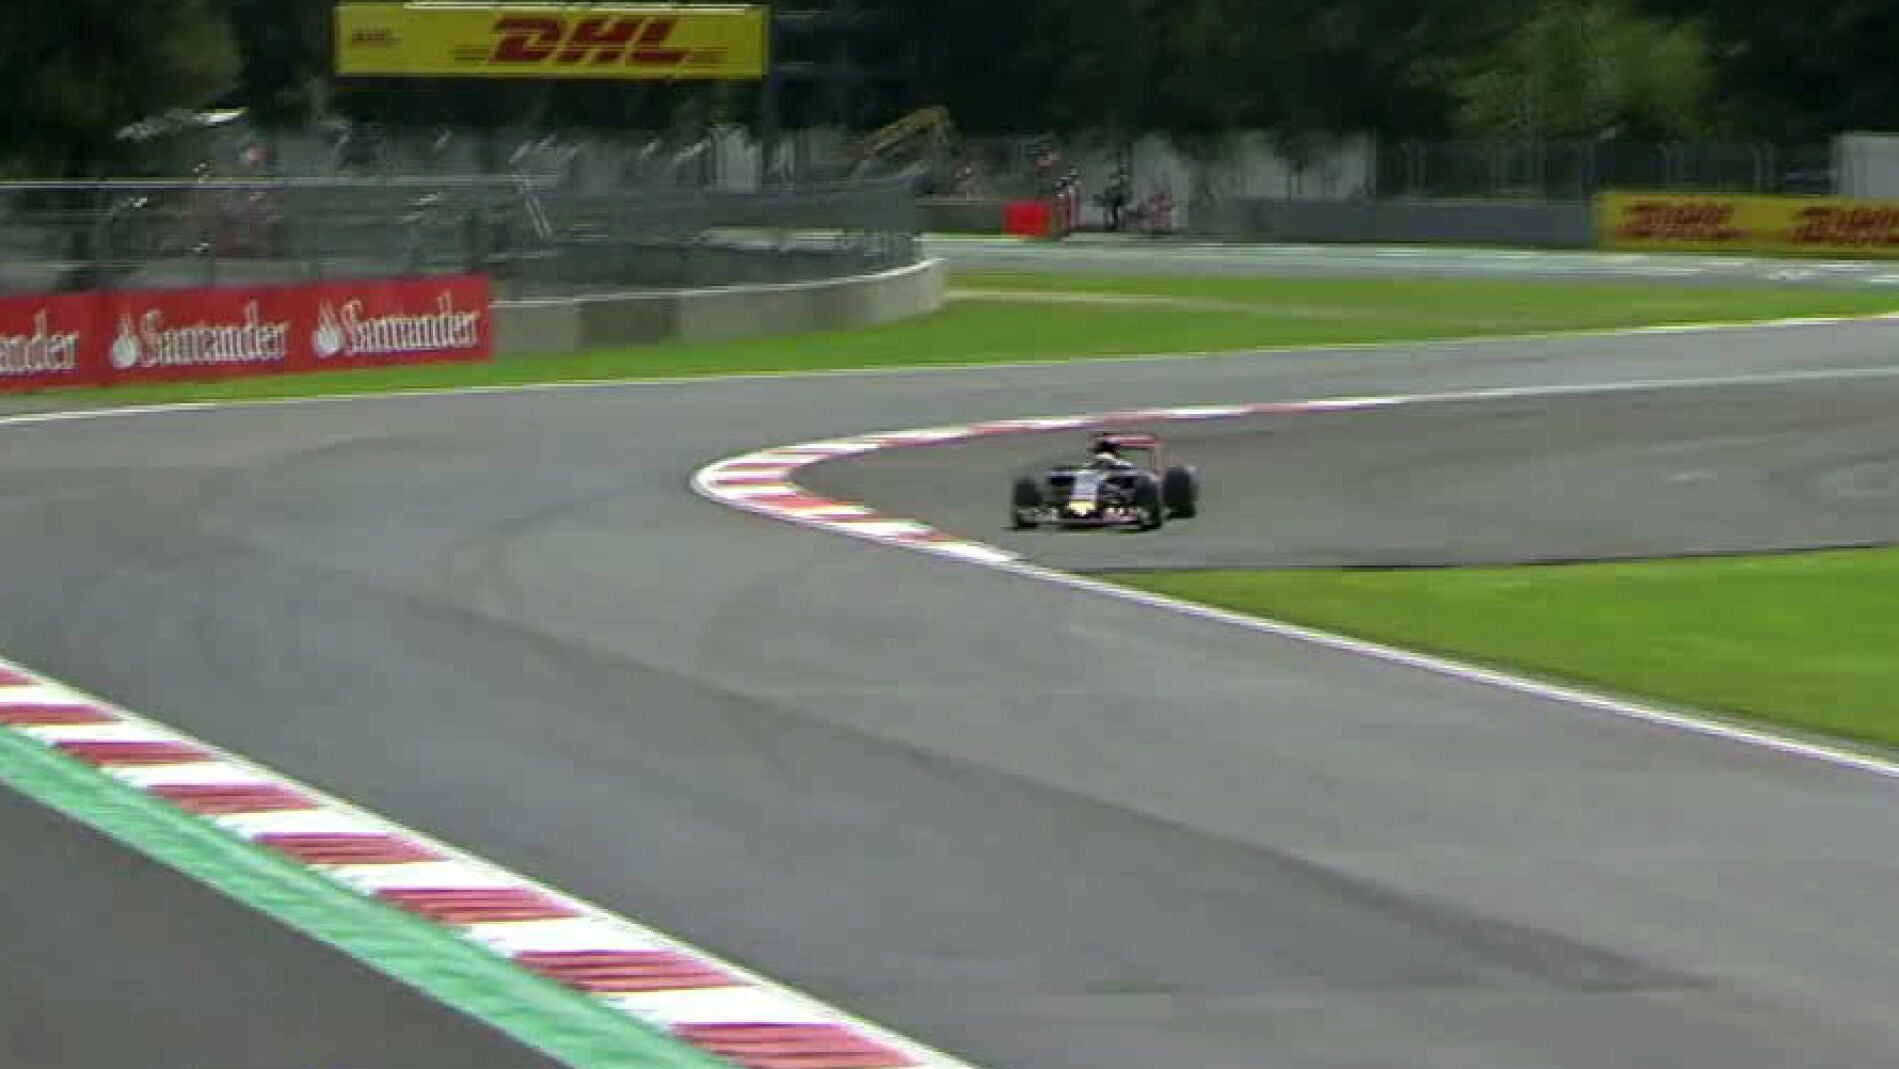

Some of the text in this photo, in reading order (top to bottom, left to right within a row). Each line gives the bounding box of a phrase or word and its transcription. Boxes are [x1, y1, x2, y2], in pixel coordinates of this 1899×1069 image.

[488, 17, 693, 64] DHL
[140, 300, 288, 366] Santander
[341, 291, 479, 355] Santander
